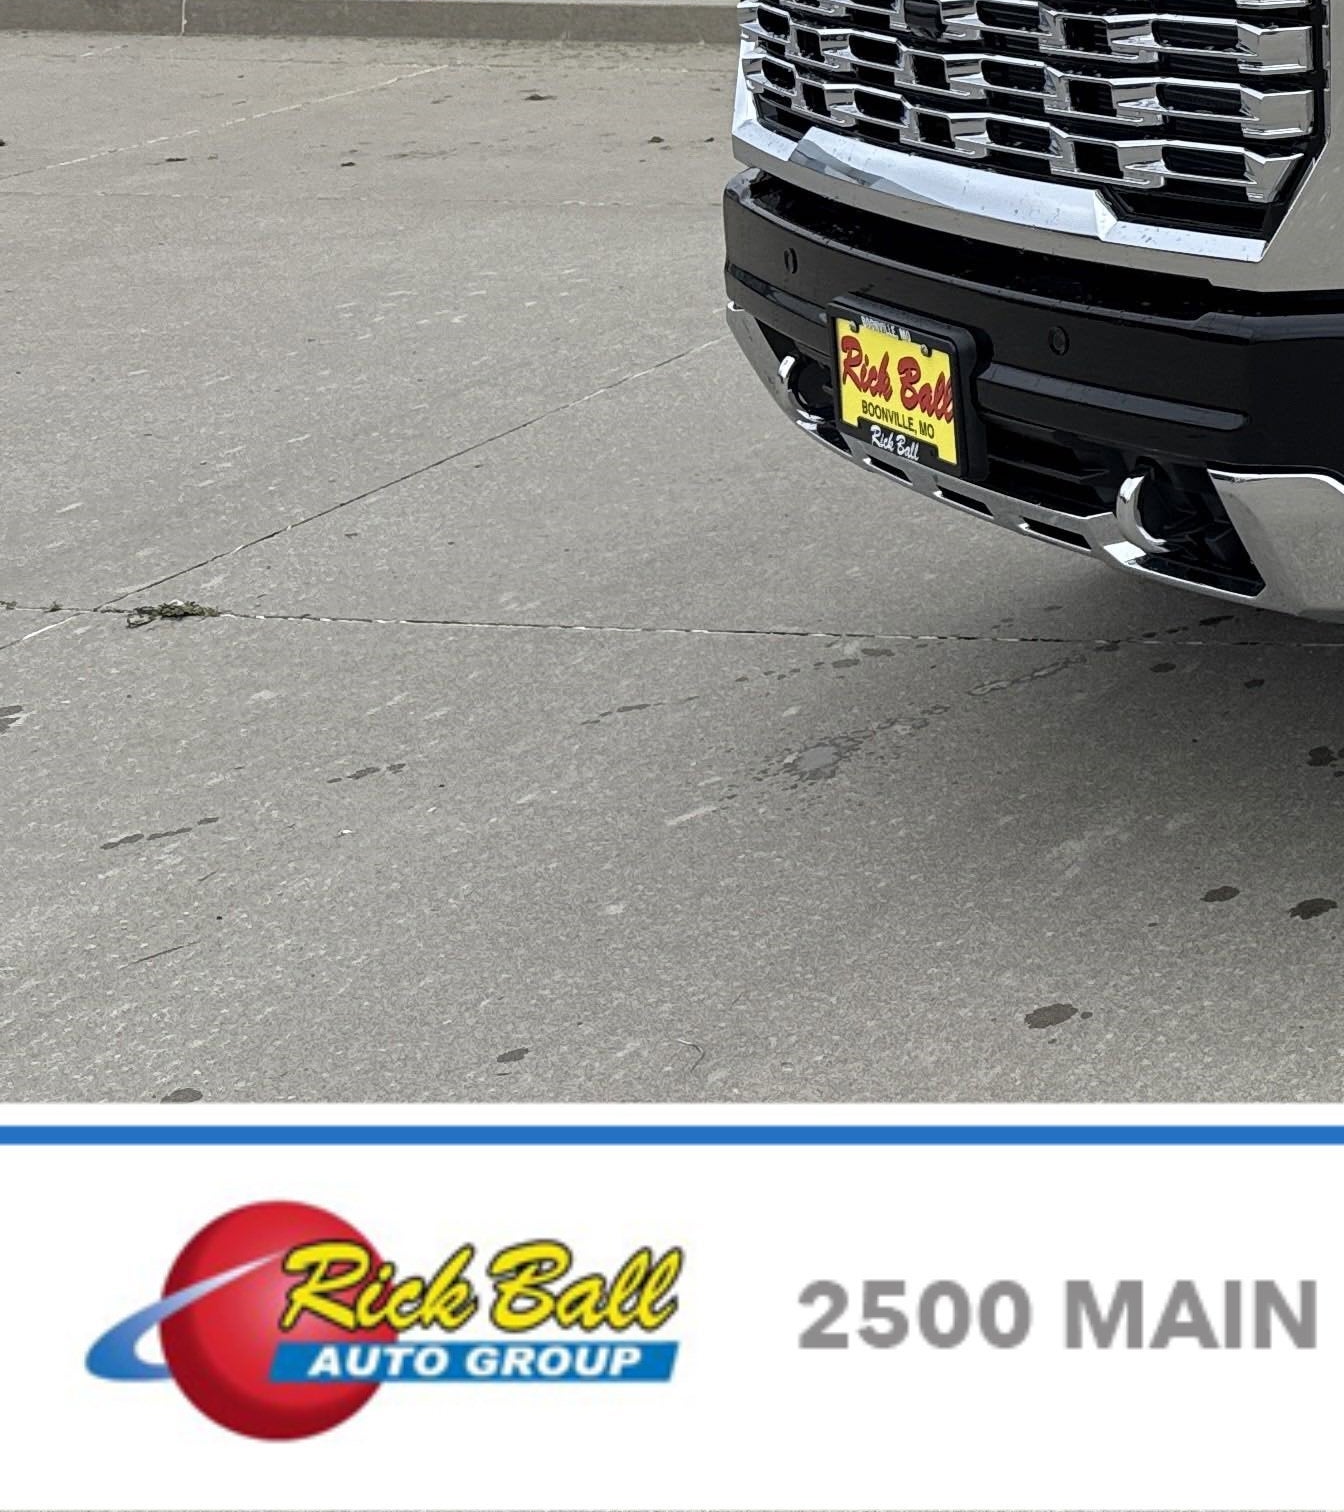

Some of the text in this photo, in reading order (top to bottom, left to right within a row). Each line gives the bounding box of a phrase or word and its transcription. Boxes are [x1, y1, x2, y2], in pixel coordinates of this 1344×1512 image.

[841, 335, 954, 424] Rick Ball
[862, 399, 935, 439] BOONVILLE, MO
[870, 424, 920, 461] Rick Ball
